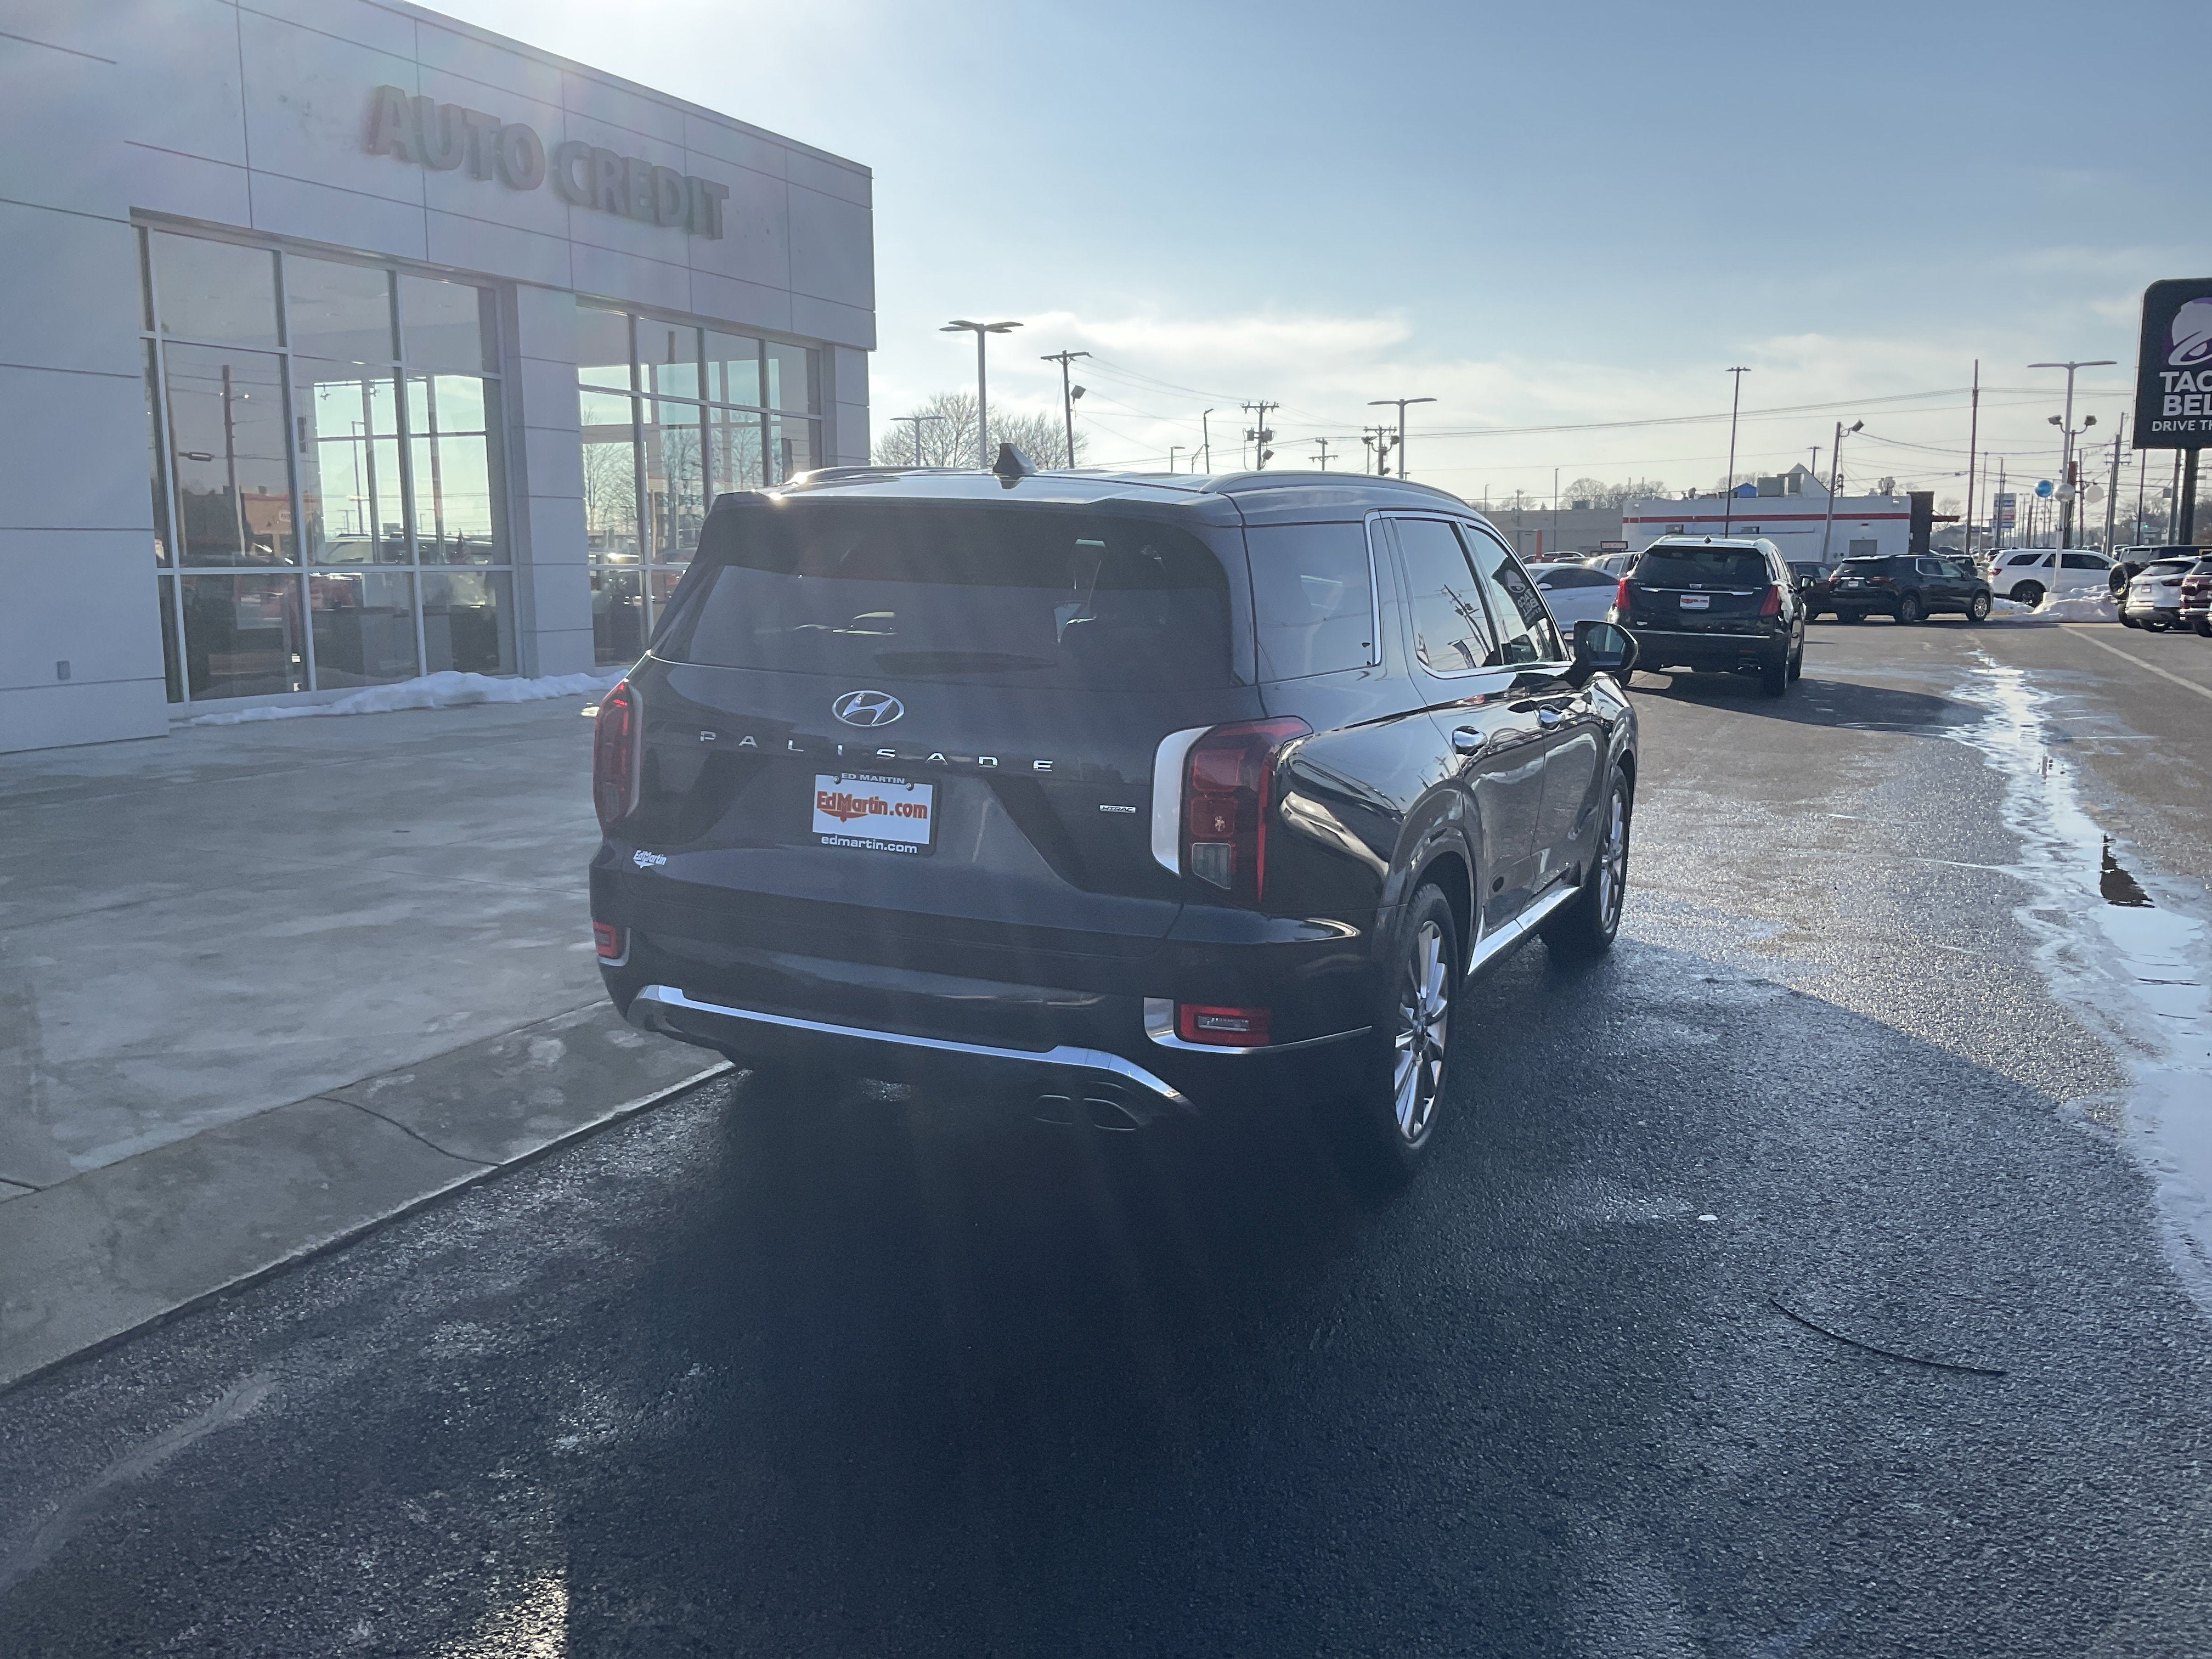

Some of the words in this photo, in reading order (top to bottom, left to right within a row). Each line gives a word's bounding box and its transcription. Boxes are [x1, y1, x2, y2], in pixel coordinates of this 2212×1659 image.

[361, 84, 545, 190] AUTO
[549, 140, 729, 240] CREDIT
[2152, 420, 2196, 432] DRIVE
[699, 730, 1054, 772] PALISADE
[860, 774, 905, 784] MARTIN
[816, 791, 928, 821] EdMartin.com
[821, 835, 917, 854] edmartin.com
[633, 850, 667, 866] EdMartin
